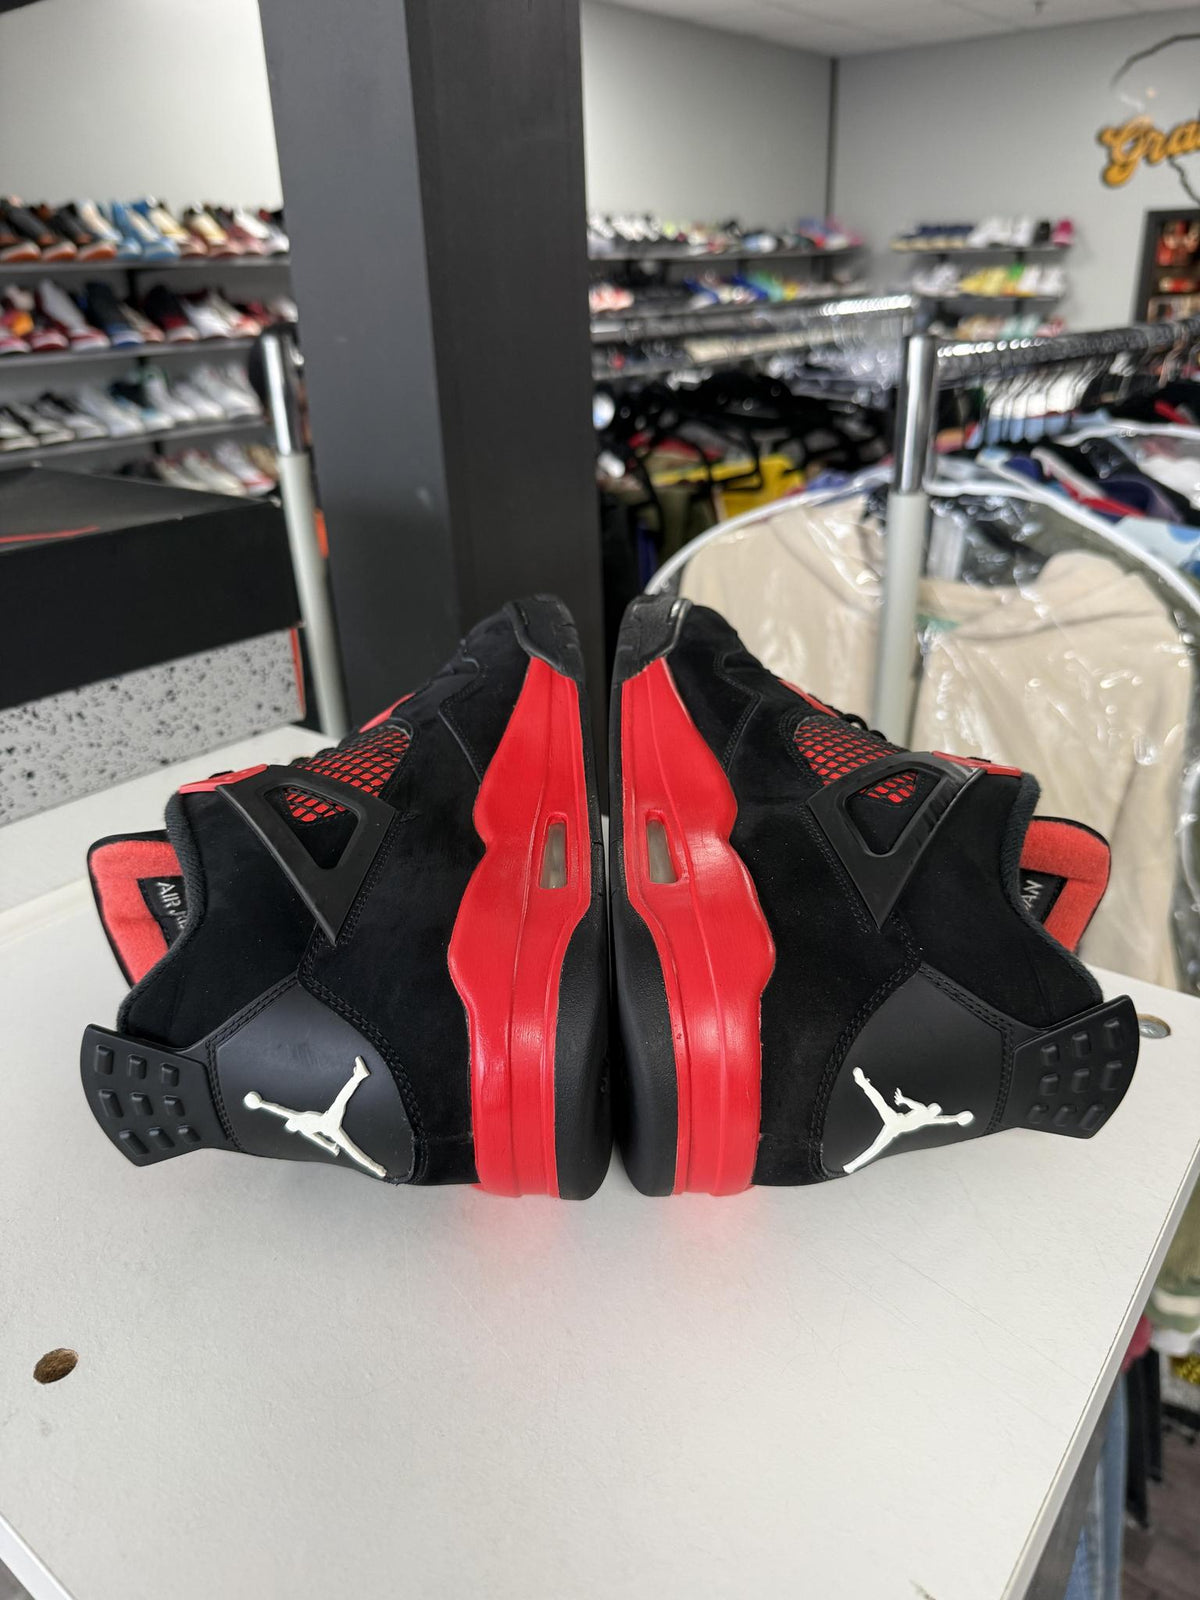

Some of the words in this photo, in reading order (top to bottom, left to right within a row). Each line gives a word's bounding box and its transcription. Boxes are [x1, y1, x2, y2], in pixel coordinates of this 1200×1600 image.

[1097, 115, 1200, 188] Gra
[156, 882, 182, 909] AIR
[1021, 879, 1042, 912] AN
